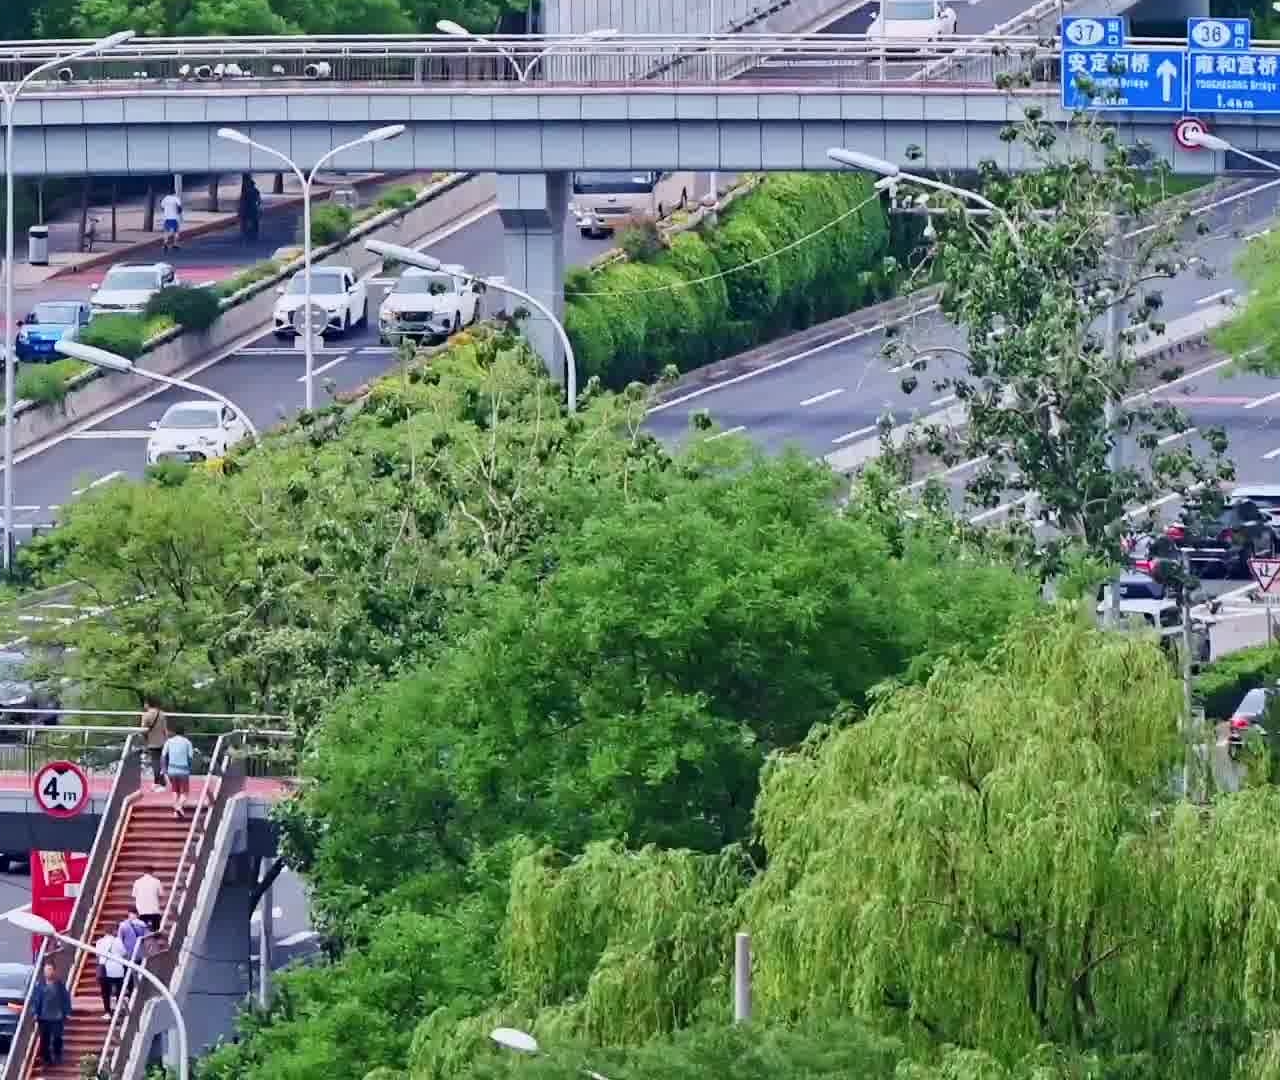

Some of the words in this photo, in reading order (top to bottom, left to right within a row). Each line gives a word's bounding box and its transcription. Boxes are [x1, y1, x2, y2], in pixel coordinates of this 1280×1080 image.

[1074, 24, 1095, 42] 37
[1107, 19, 1119, 45] 出口
[1234, 23, 1245, 48] 出口
[1195, 55, 1277, 76] 雍和宫桥
